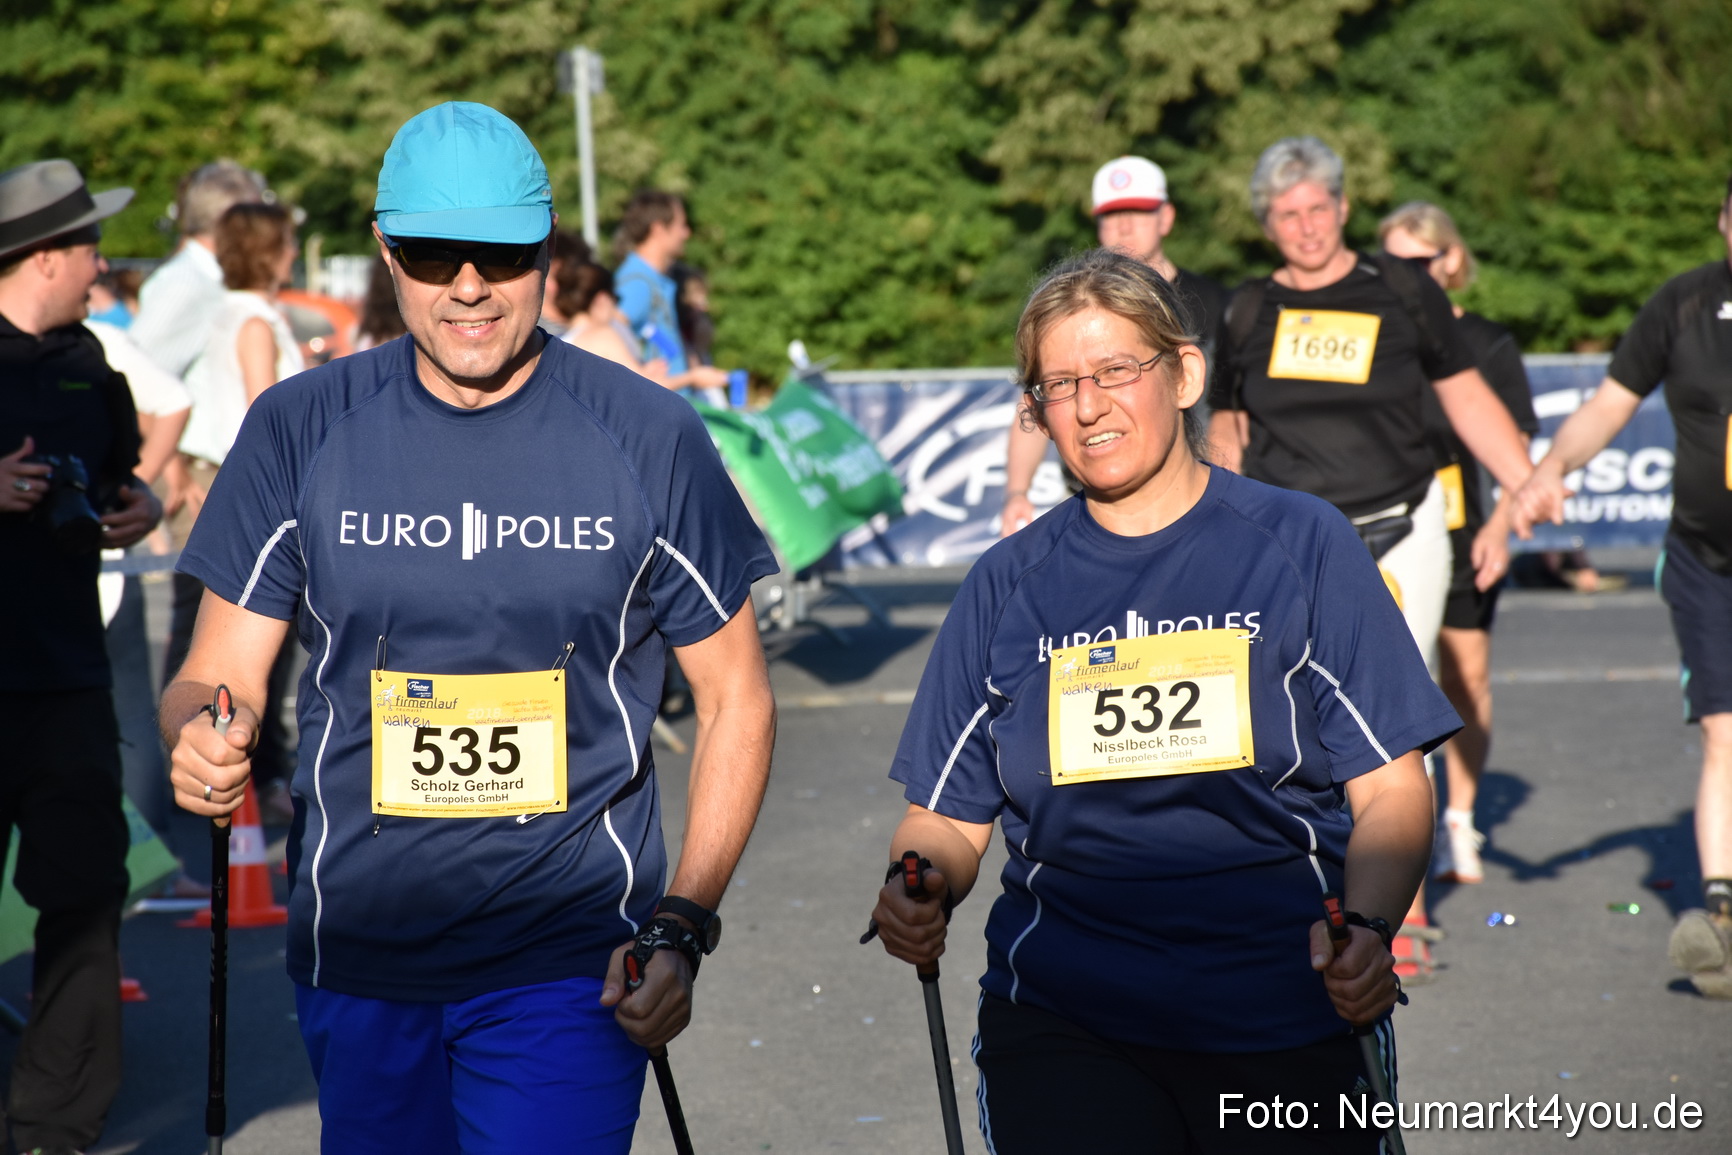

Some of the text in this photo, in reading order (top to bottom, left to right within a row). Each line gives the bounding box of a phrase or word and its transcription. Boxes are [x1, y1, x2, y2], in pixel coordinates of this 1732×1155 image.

[1290, 335, 1357, 362] 1696
[339, 510, 615, 551] EURO POLES
[1076, 658, 1141, 677] firmenlauf
[1148, 663, 1183, 677] 2018
[1062, 680, 1113, 696] walken
[395, 695, 459, 710] firmenlauf
[1093, 681, 1202, 737] 532
[382, 714, 431, 729] walken
[466, 707, 503, 720] 2018
[412, 725, 521, 776] 535
[1093, 733, 1208, 754] Nisslbeck Rosa
[1107, 749, 1193, 765] Europoles GmbH
[411, 777, 524, 792] Scholz Gerhard
[424, 793, 509, 805] Europoles GmbH
